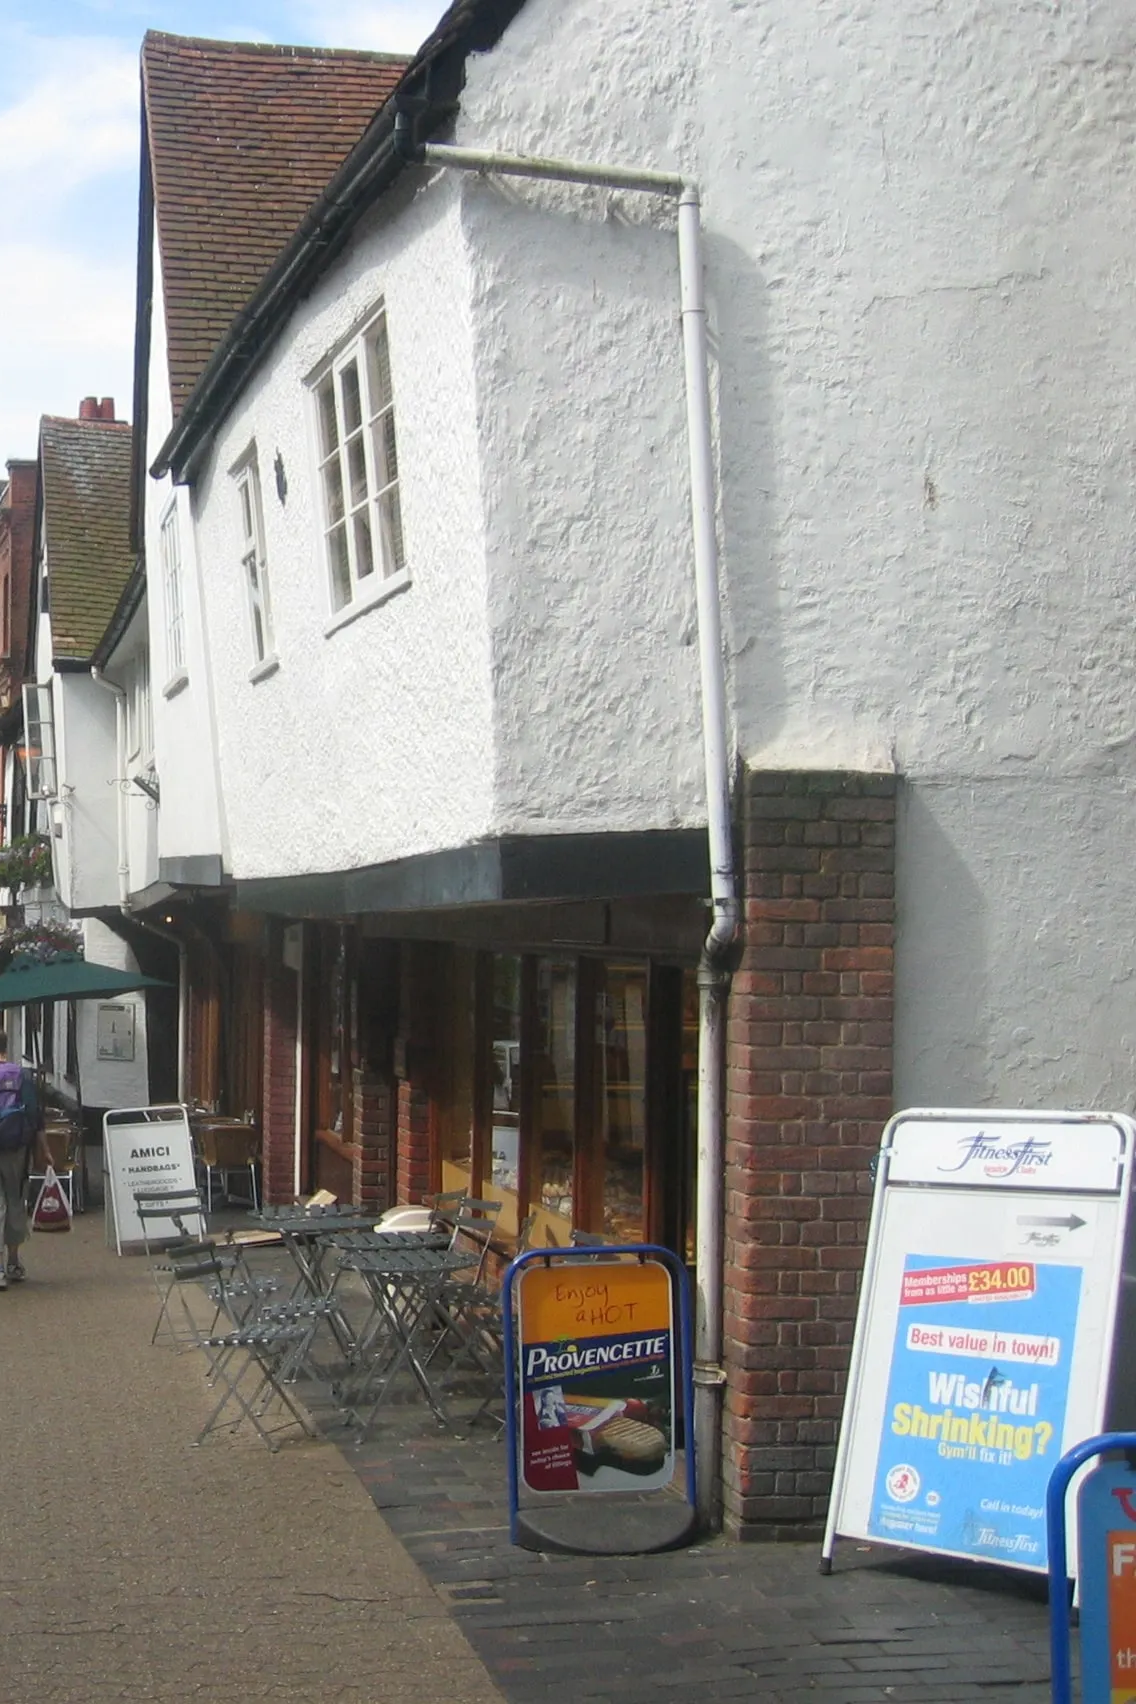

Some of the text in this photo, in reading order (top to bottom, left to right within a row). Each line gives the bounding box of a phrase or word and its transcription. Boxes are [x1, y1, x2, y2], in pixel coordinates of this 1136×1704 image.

[130, 1146, 171, 1159] AMICI
[904, 1272, 967, 1286] Memberships
[904, 1284, 967, 1297] from as little as
[968, 1266, 1030, 1291] £34.00
[555, 1283, 608, 1308] Enjoy
[575, 1302, 638, 1325] a HOT
[911, 1327, 1054, 1358] Best value in town!
[527, 1336, 666, 1376] PROVENCETTE
[928, 1371, 1038, 1416] Wishful
[891, 1402, 1052, 1460] Shrinking?
[980, 1447, 995, 1464] fix
[998, 1450, 1012, 1465] it!
[980, 1499, 1043, 1519] Call in today!
